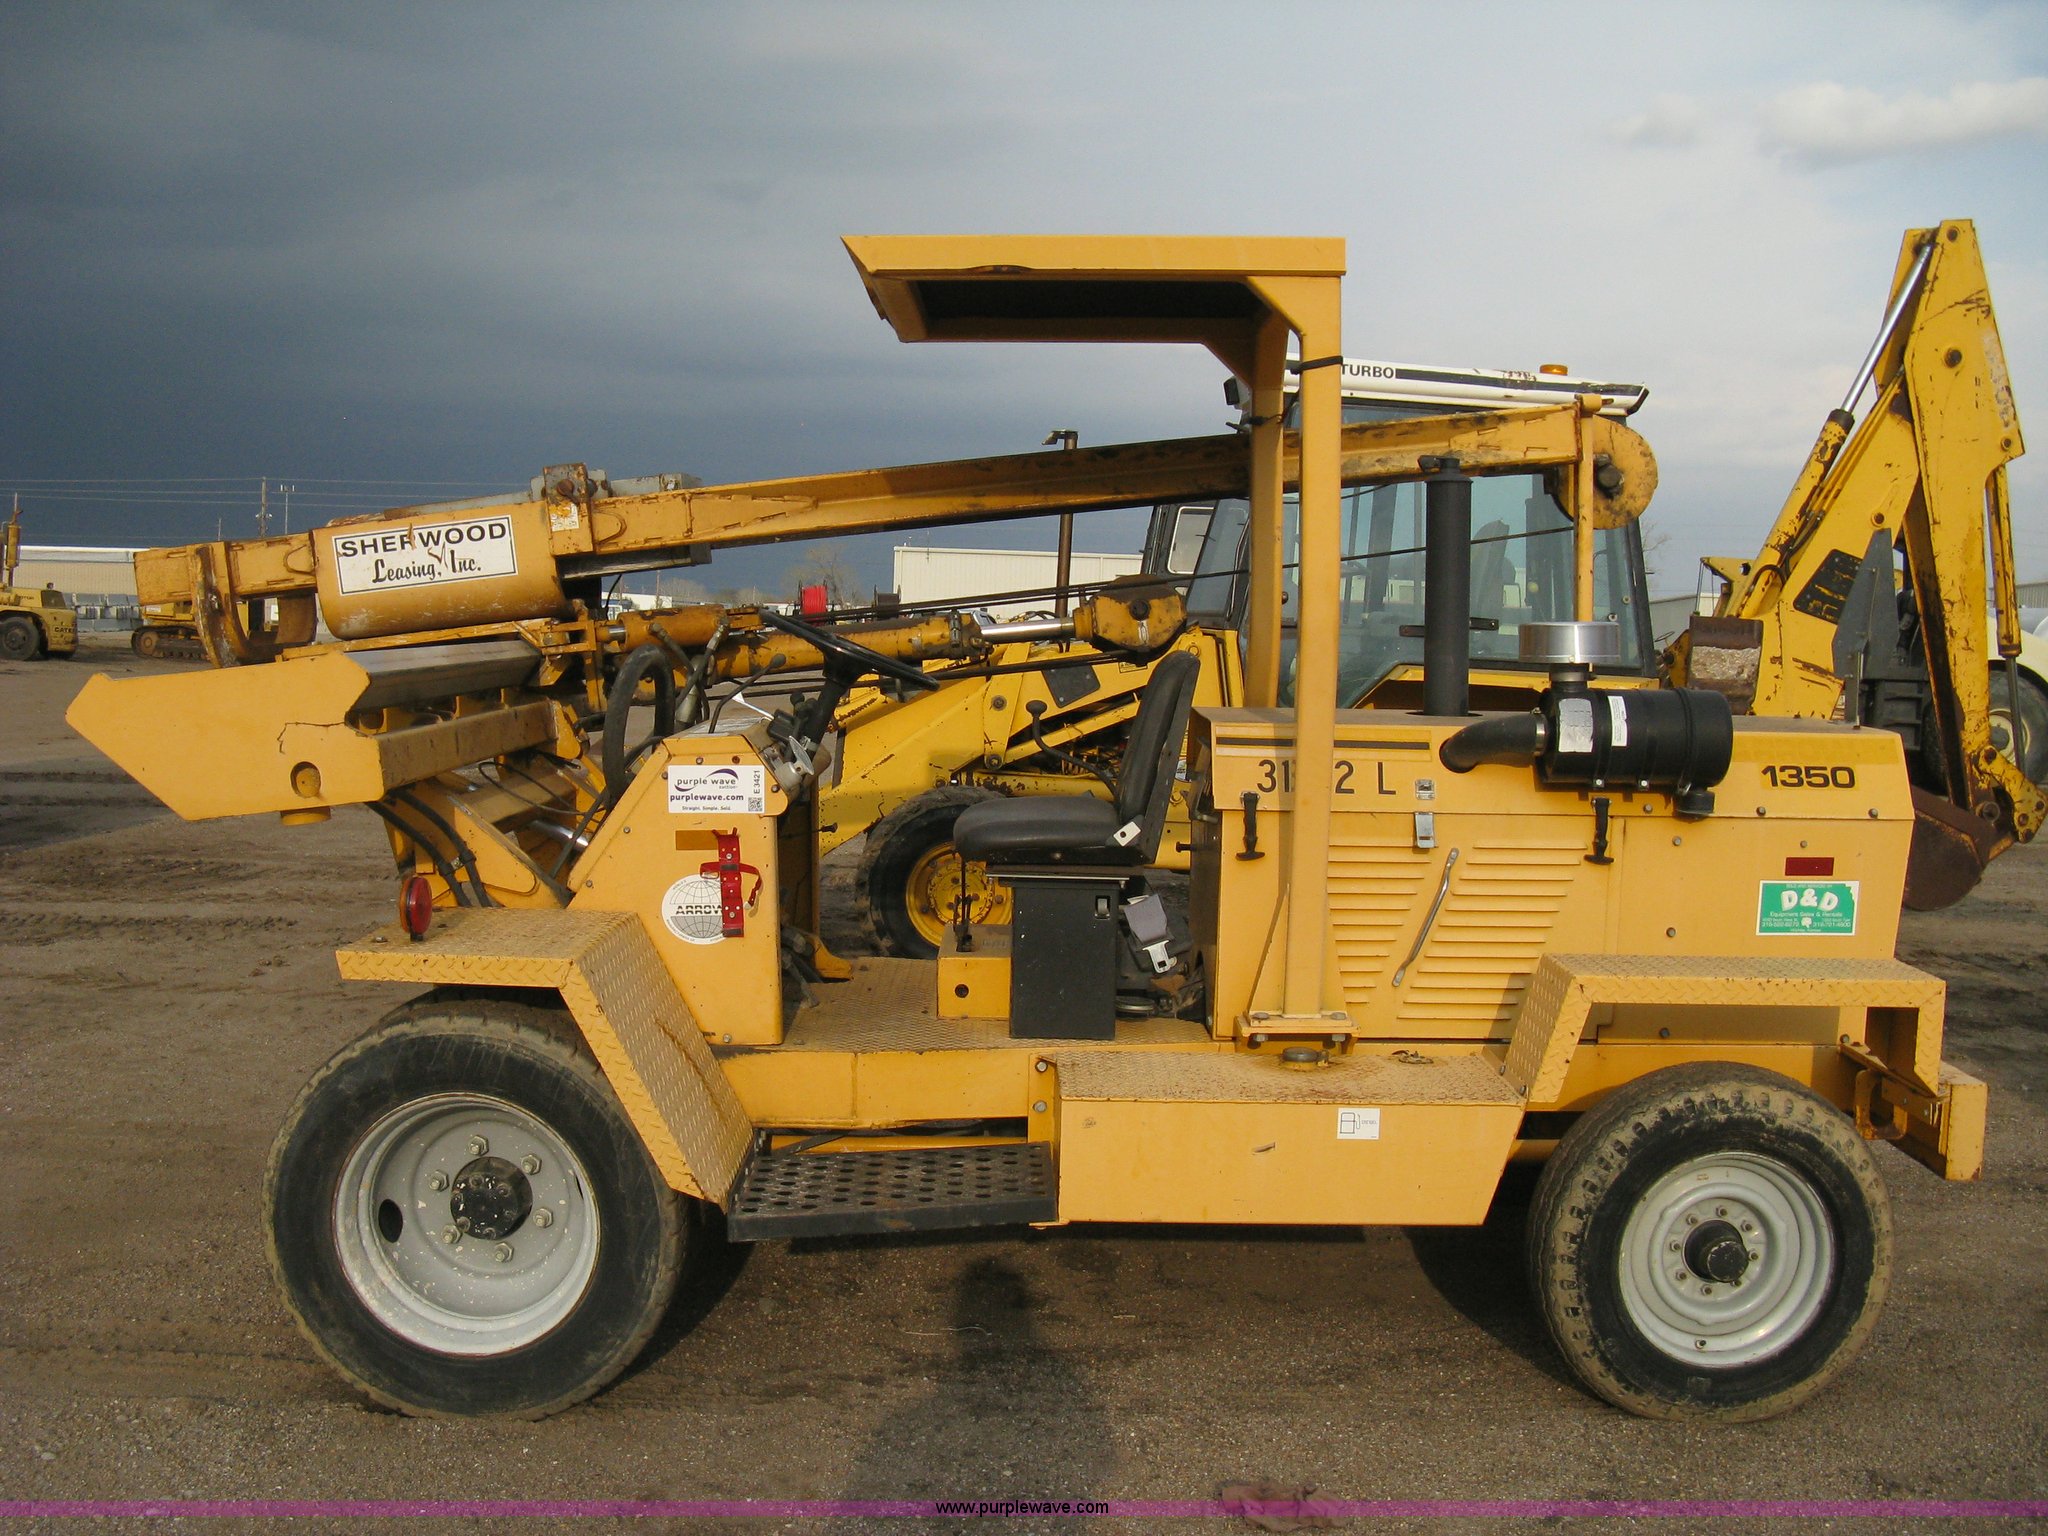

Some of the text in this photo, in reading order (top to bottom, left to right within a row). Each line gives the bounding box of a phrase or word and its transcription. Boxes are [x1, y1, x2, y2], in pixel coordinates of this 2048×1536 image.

[1342, 364, 1394, 379] TURBO
[341, 523, 507, 557] SHERWOOD
[372, 549, 482, 584] Leasing, Inc.
[677, 777, 707, 786] purple
[1378, 762, 1396, 795] L
[1761, 765, 1856, 789] 1350
[670, 793, 744, 802] purplewave.com
